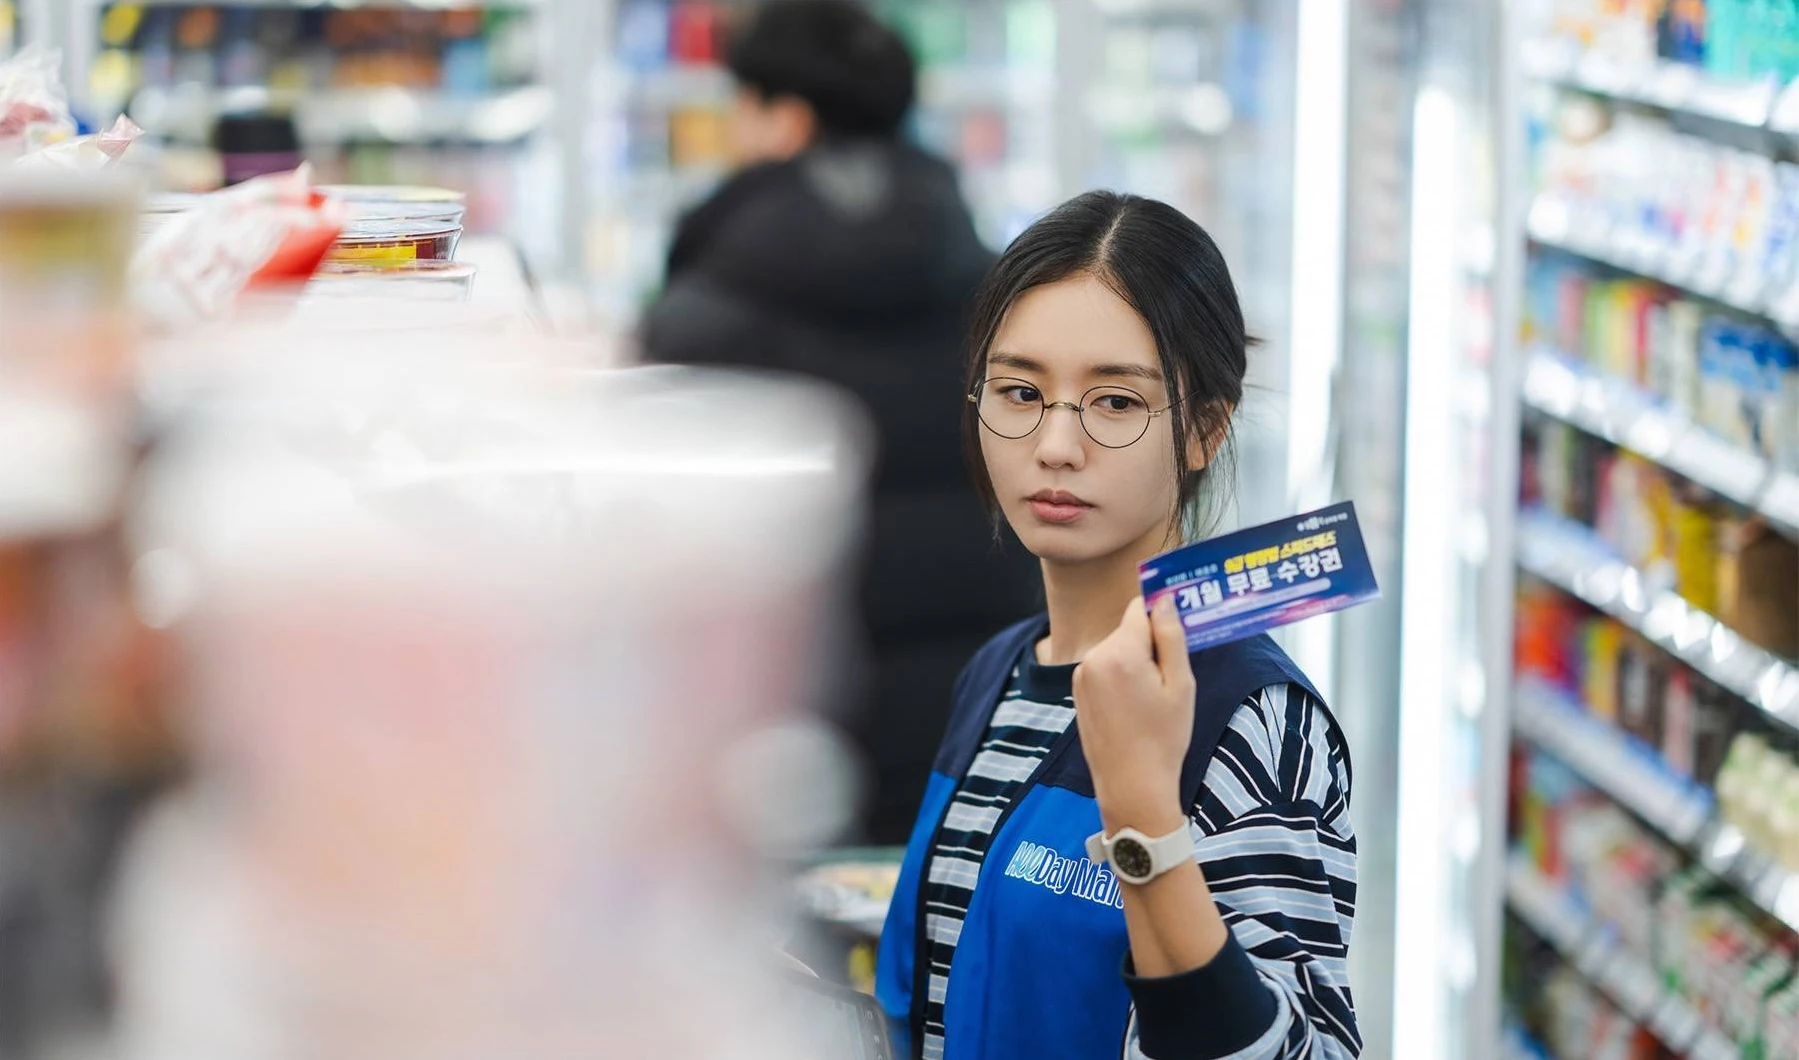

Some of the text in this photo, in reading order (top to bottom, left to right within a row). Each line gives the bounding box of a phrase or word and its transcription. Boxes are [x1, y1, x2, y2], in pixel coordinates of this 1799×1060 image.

[1178, 580, 1224, 609] 개월
[1227, 566, 1273, 596] 무료
[1277, 547, 1343, 583] 수강권
